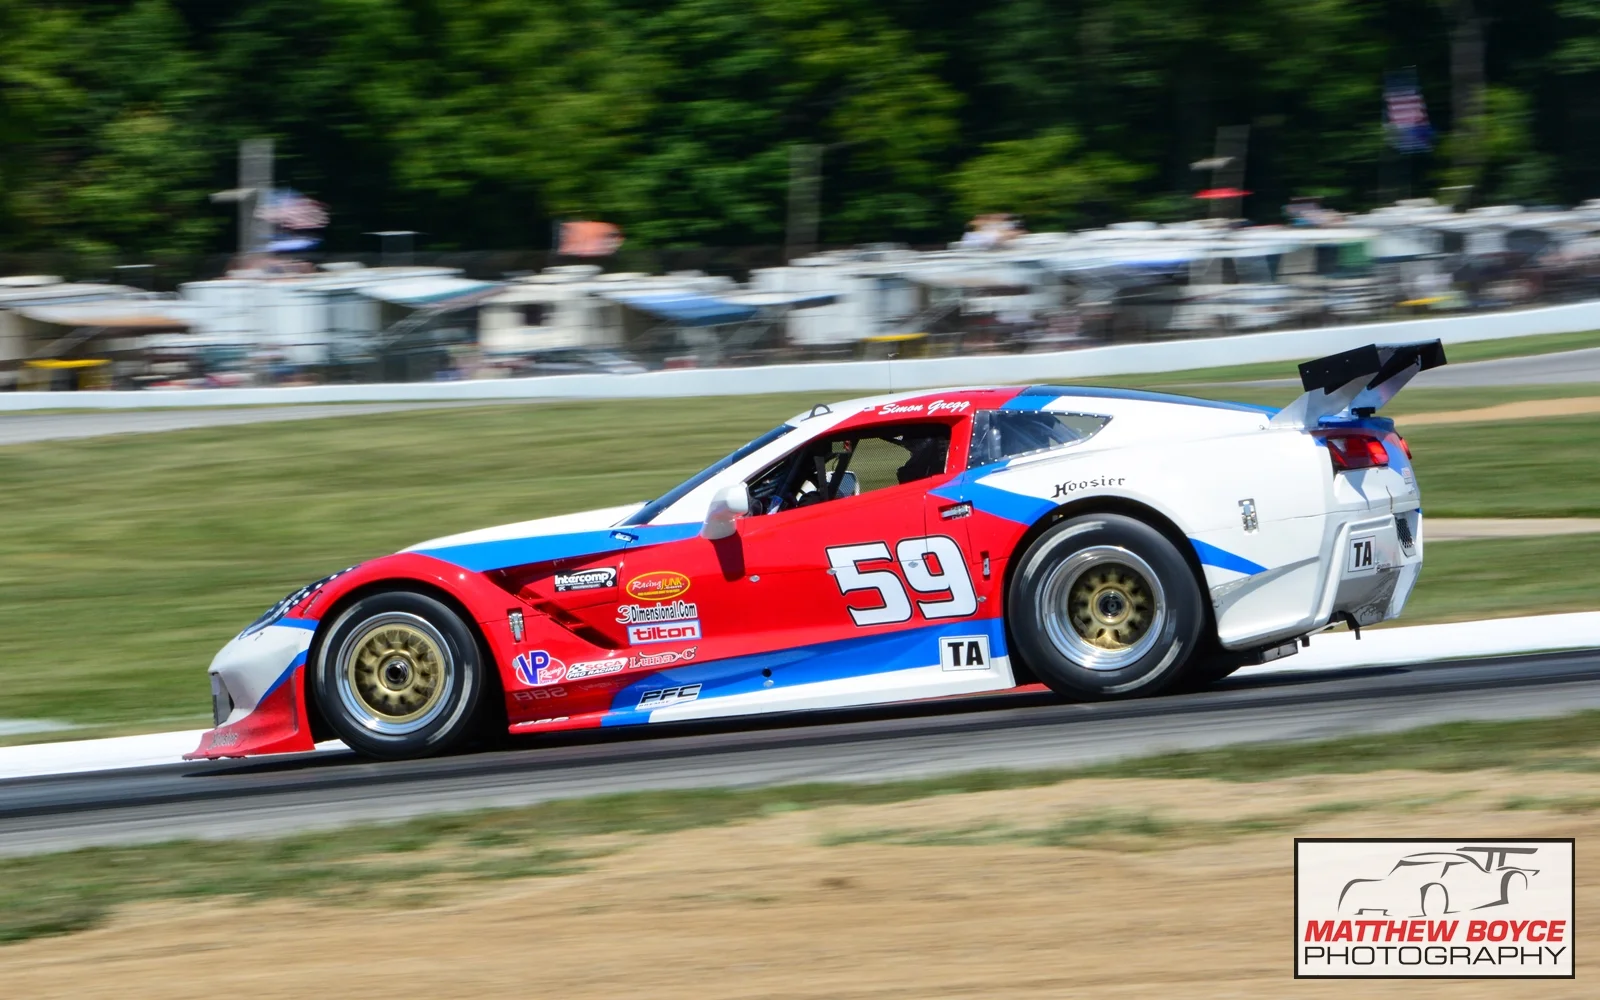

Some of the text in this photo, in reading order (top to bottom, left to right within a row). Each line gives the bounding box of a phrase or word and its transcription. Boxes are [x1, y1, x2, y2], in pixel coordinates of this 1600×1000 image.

[878, 400, 970, 415] Simon Gregg
[1050, 475, 1126, 499] Hoosier
[1354, 541, 1372, 567] TA
[554, 573, 610, 585] Intercomp
[825, 534, 978, 627] 59
[633, 626, 696, 641] tilton
[947, 641, 984, 667] TA
[516, 650, 550, 685] VP
[585, 660, 622, 671] SCCA
[640, 684, 701, 704] PFC
